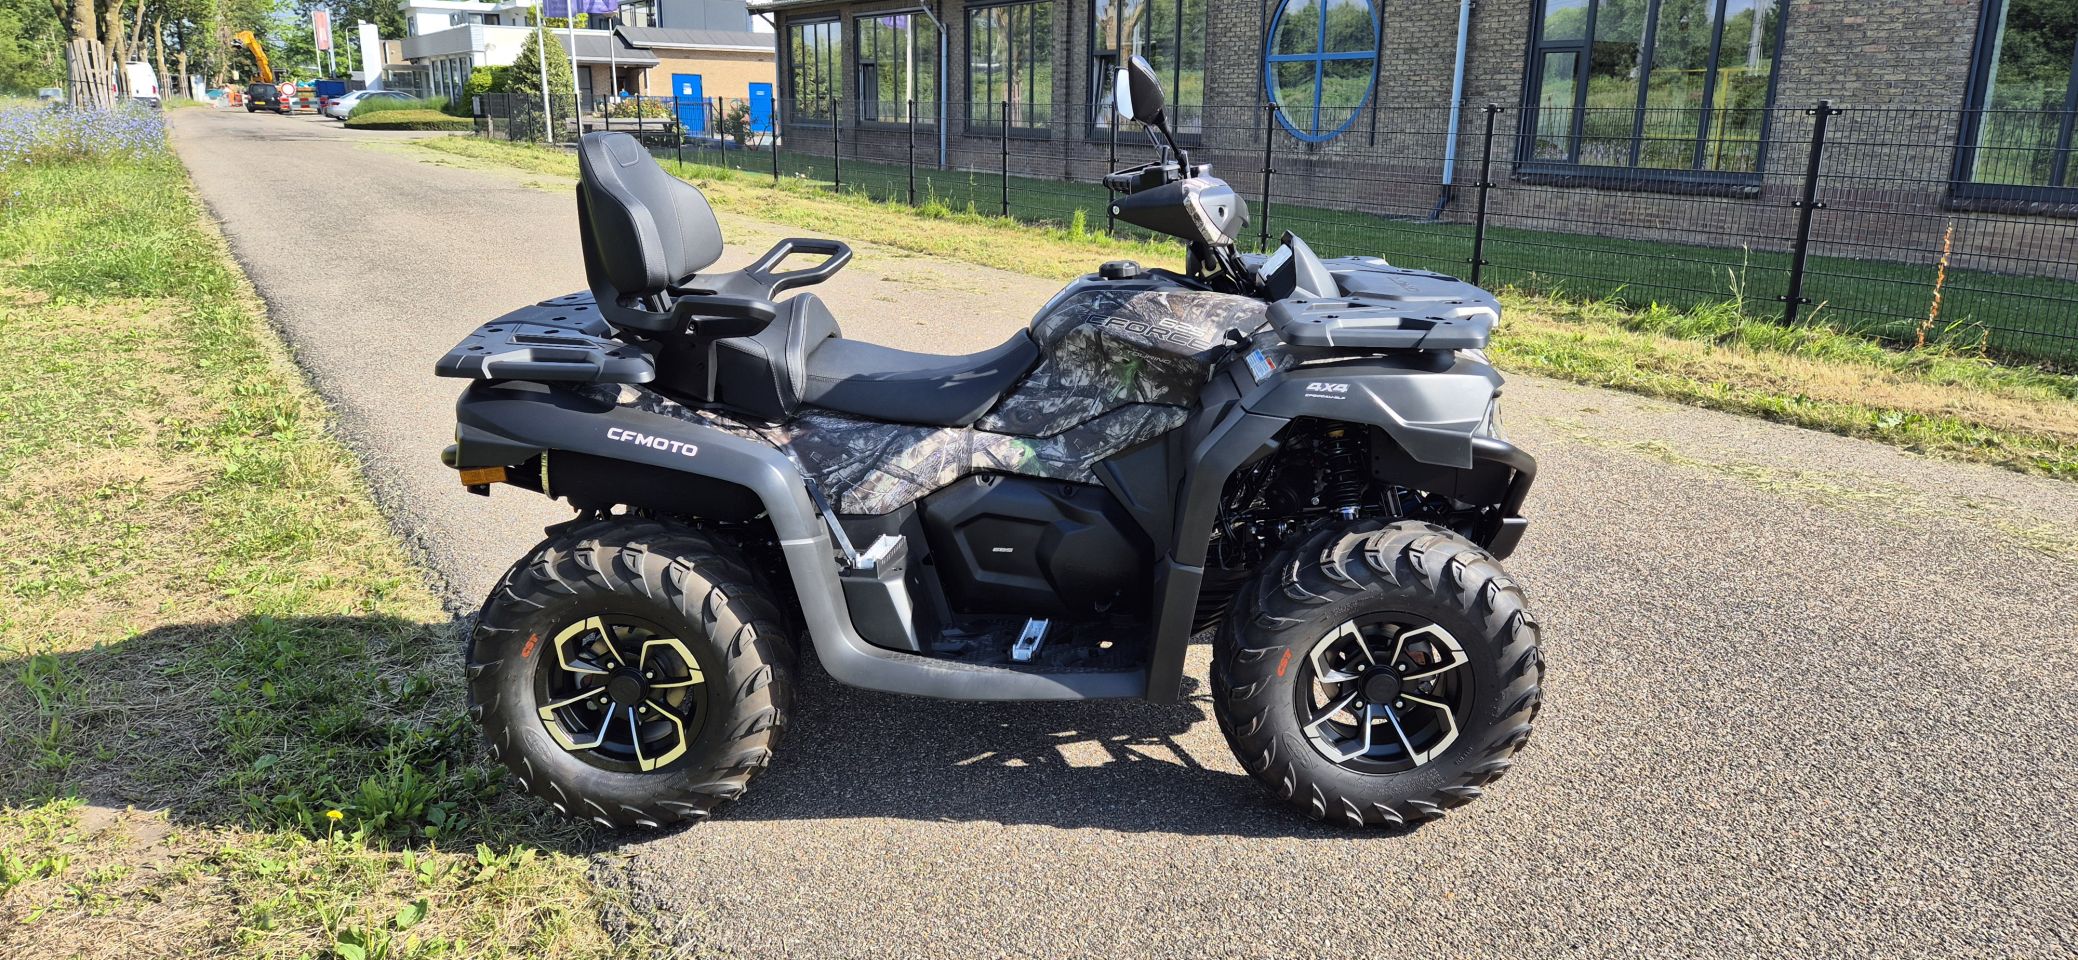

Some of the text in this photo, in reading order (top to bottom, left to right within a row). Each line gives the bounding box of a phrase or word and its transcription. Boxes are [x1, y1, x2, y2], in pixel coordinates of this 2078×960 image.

[1085, 314, 1212, 351] CFORCE
[607, 427, 698, 457] CFMOTO
[521, 633, 539, 657] CST
